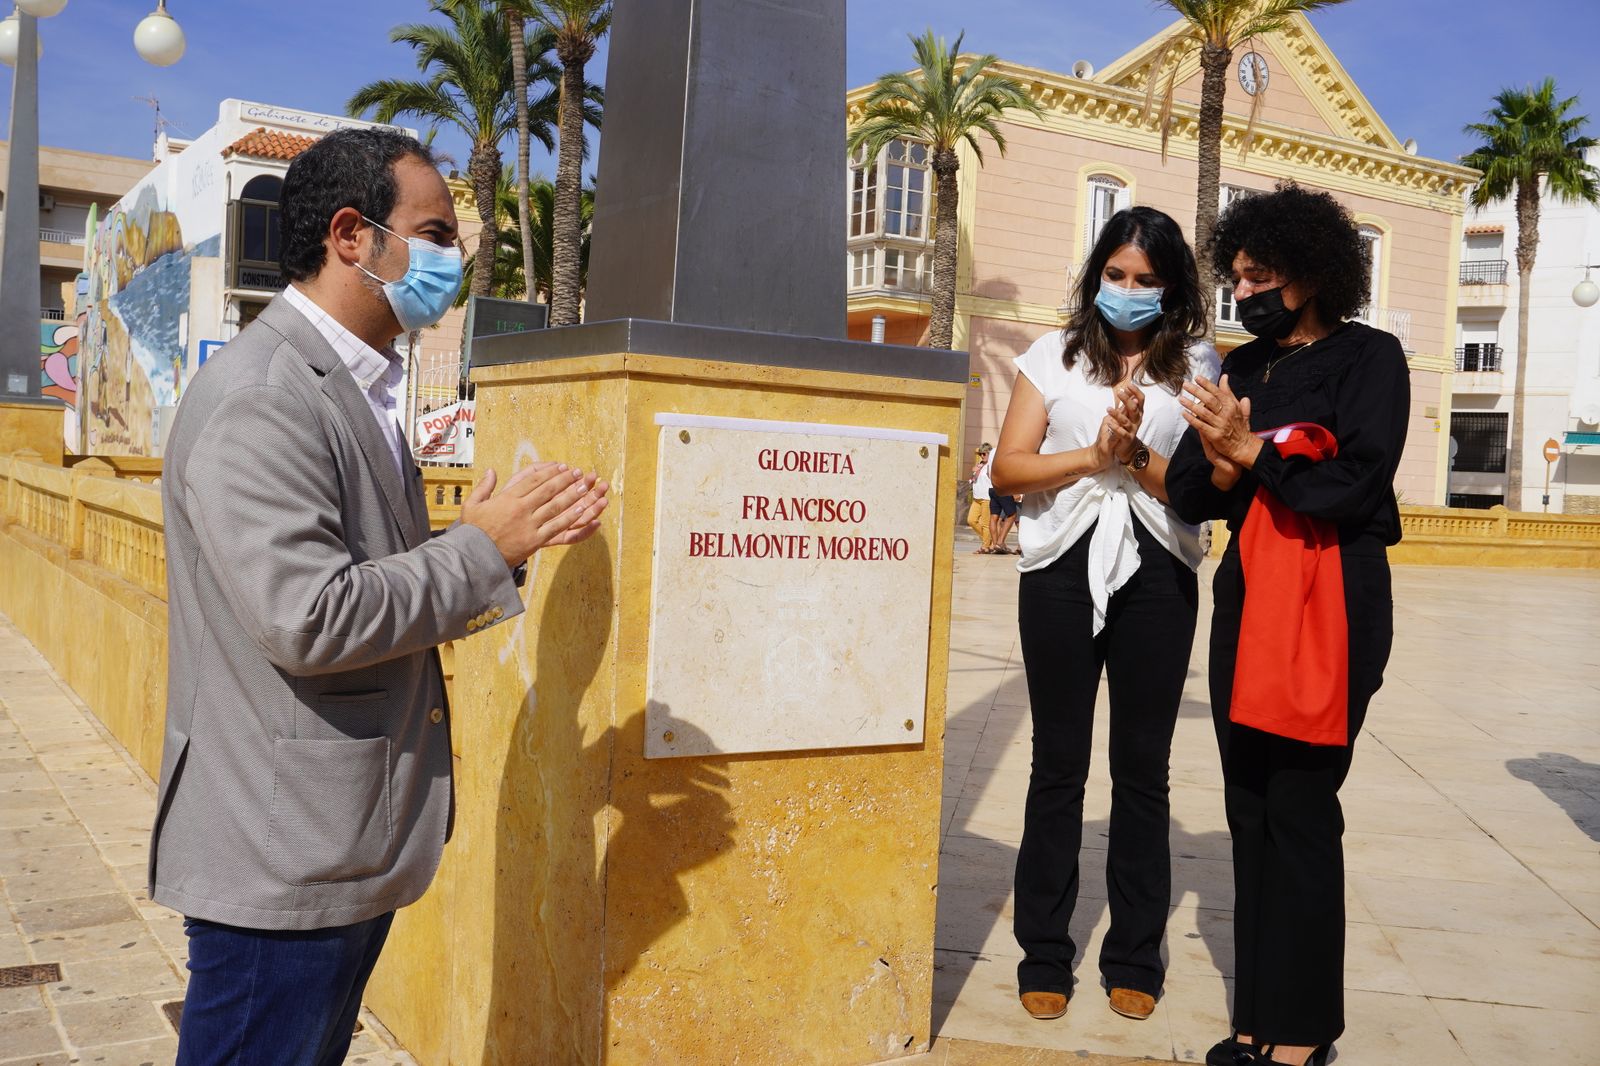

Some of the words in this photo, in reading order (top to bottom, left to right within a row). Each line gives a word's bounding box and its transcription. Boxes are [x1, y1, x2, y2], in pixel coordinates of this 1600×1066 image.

[423, 415, 452, 434] POR
[758, 448, 855, 475] GLORIETA
[742, 495, 867, 523] FRANCISCO
[689, 532, 811, 559] BELMONTE
[816, 535, 909, 561] MORENO
